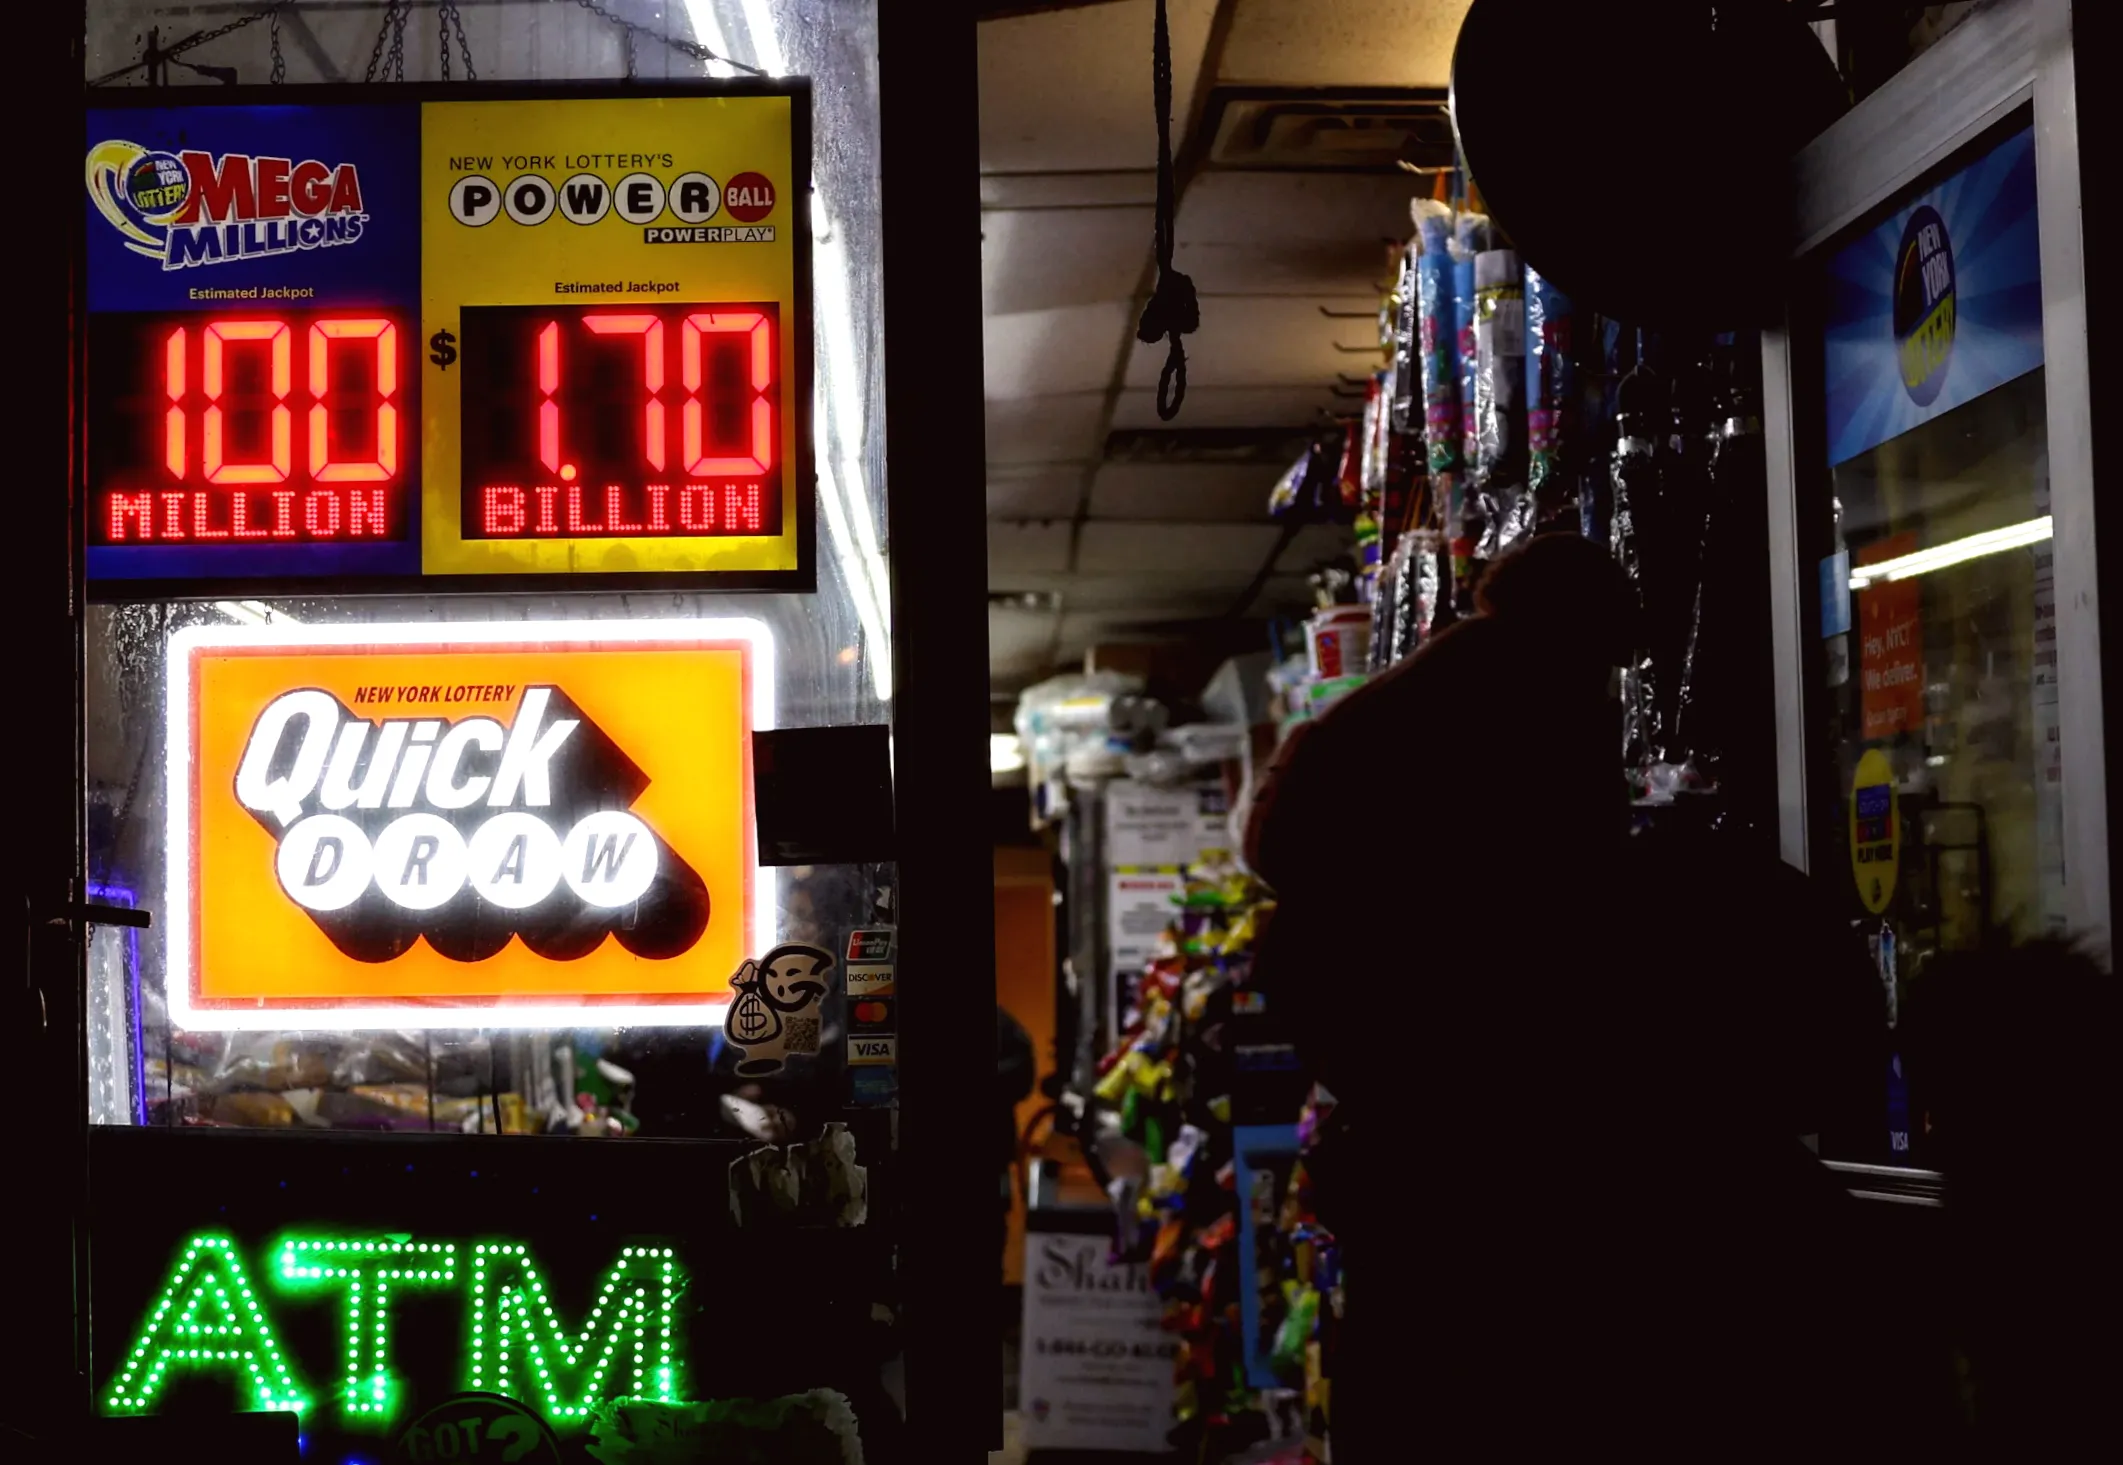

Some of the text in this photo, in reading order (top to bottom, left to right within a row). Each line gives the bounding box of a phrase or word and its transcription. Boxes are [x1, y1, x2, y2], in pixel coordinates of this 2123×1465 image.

[154, 159, 178, 171] NEW
[449, 153, 674, 171] NEW YORK LOTTERY'S
[174, 150, 363, 226] MEGA
[726, 187, 773, 208] BALL
[163, 215, 364, 271] MILLIONS
[1916, 222, 1942, 262] NEW
[189, 286, 315, 301] Estimated Jackpot
[554, 280, 680, 295] Estimated Jackpot
[1921, 250, 1953, 307] YORK
[164, 316, 398, 486] 100
[429, 312, 772, 481] $ 1.70
[110, 488, 387, 540] MILLION
[483, 484, 761, 534] BILLION
[354, 684, 515, 703] NEW YORK LOTTERY
[235, 688, 580, 828] Quick
[302, 832, 638, 888] DRAW
[856, 1043, 890, 1056] VISA
[1889, 1130, 1909, 1151] VISA
[107, 1235, 676, 1418] ATM
